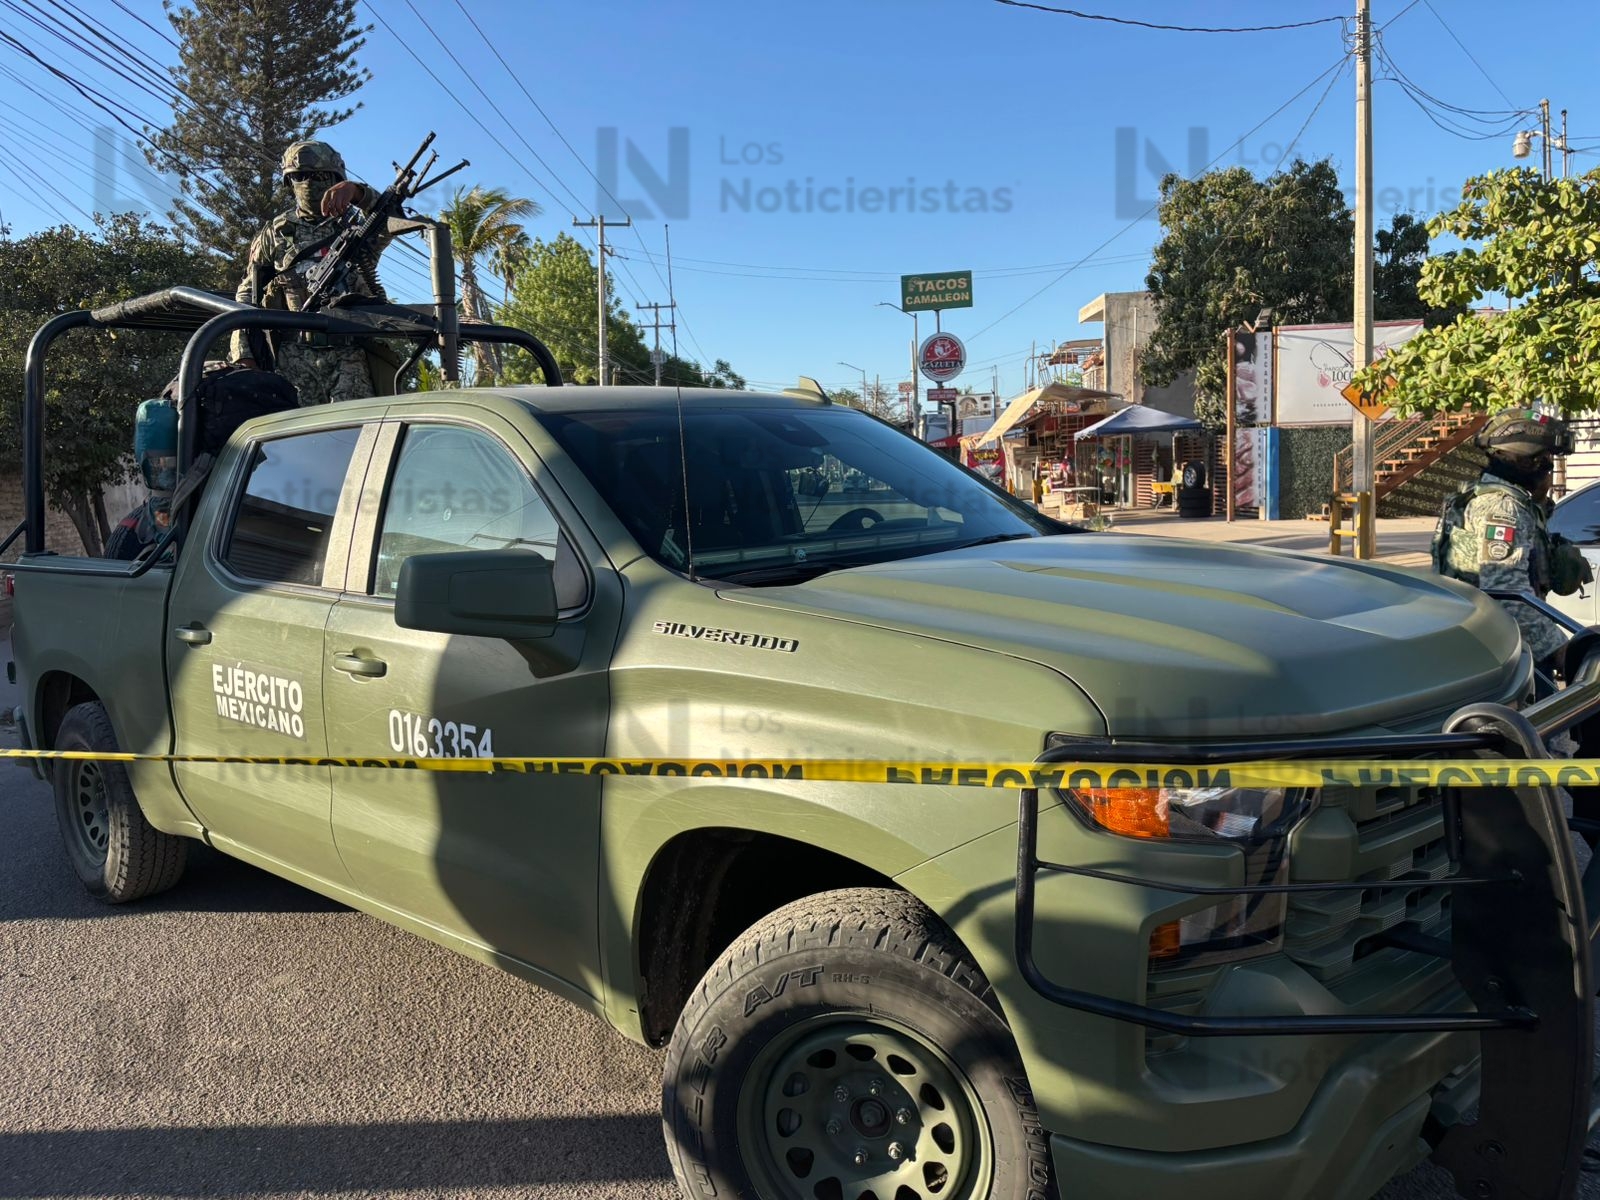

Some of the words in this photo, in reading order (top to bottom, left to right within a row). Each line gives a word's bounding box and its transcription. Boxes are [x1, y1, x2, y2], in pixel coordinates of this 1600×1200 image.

[905, 292, 970, 305] CAMALEON
[918, 277, 968, 292] TACOS
[652, 620, 800, 654] SILVERADO
[212, 661, 303, 713] EJÉRCITO
[215, 694, 304, 738] MEXICANO
[389, 709, 494, 758] 0163354
[743, 963, 824, 1018] A/T
